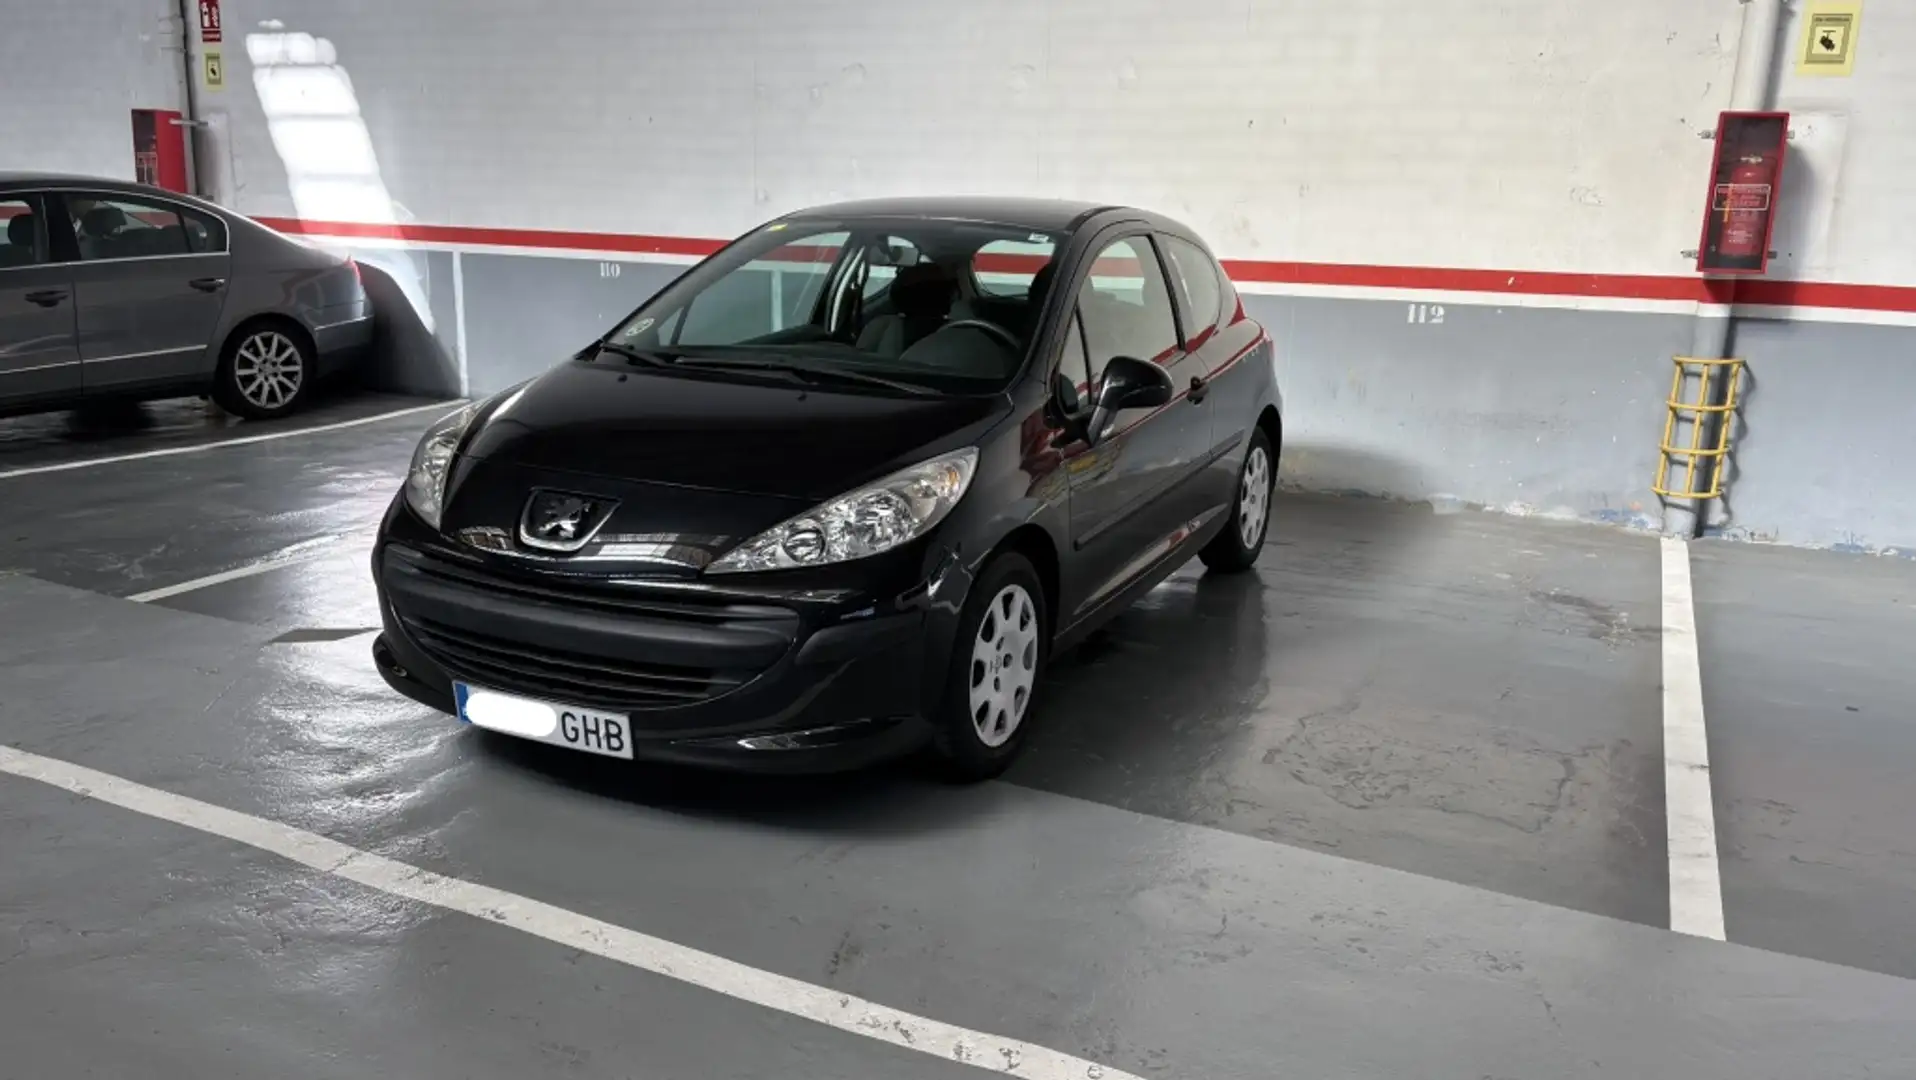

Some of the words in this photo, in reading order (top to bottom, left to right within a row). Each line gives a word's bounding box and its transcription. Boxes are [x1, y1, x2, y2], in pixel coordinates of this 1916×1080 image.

[600, 262, 621, 278] 110
[1407, 303, 1445, 324] 112
[561, 711, 625, 752] GHB
